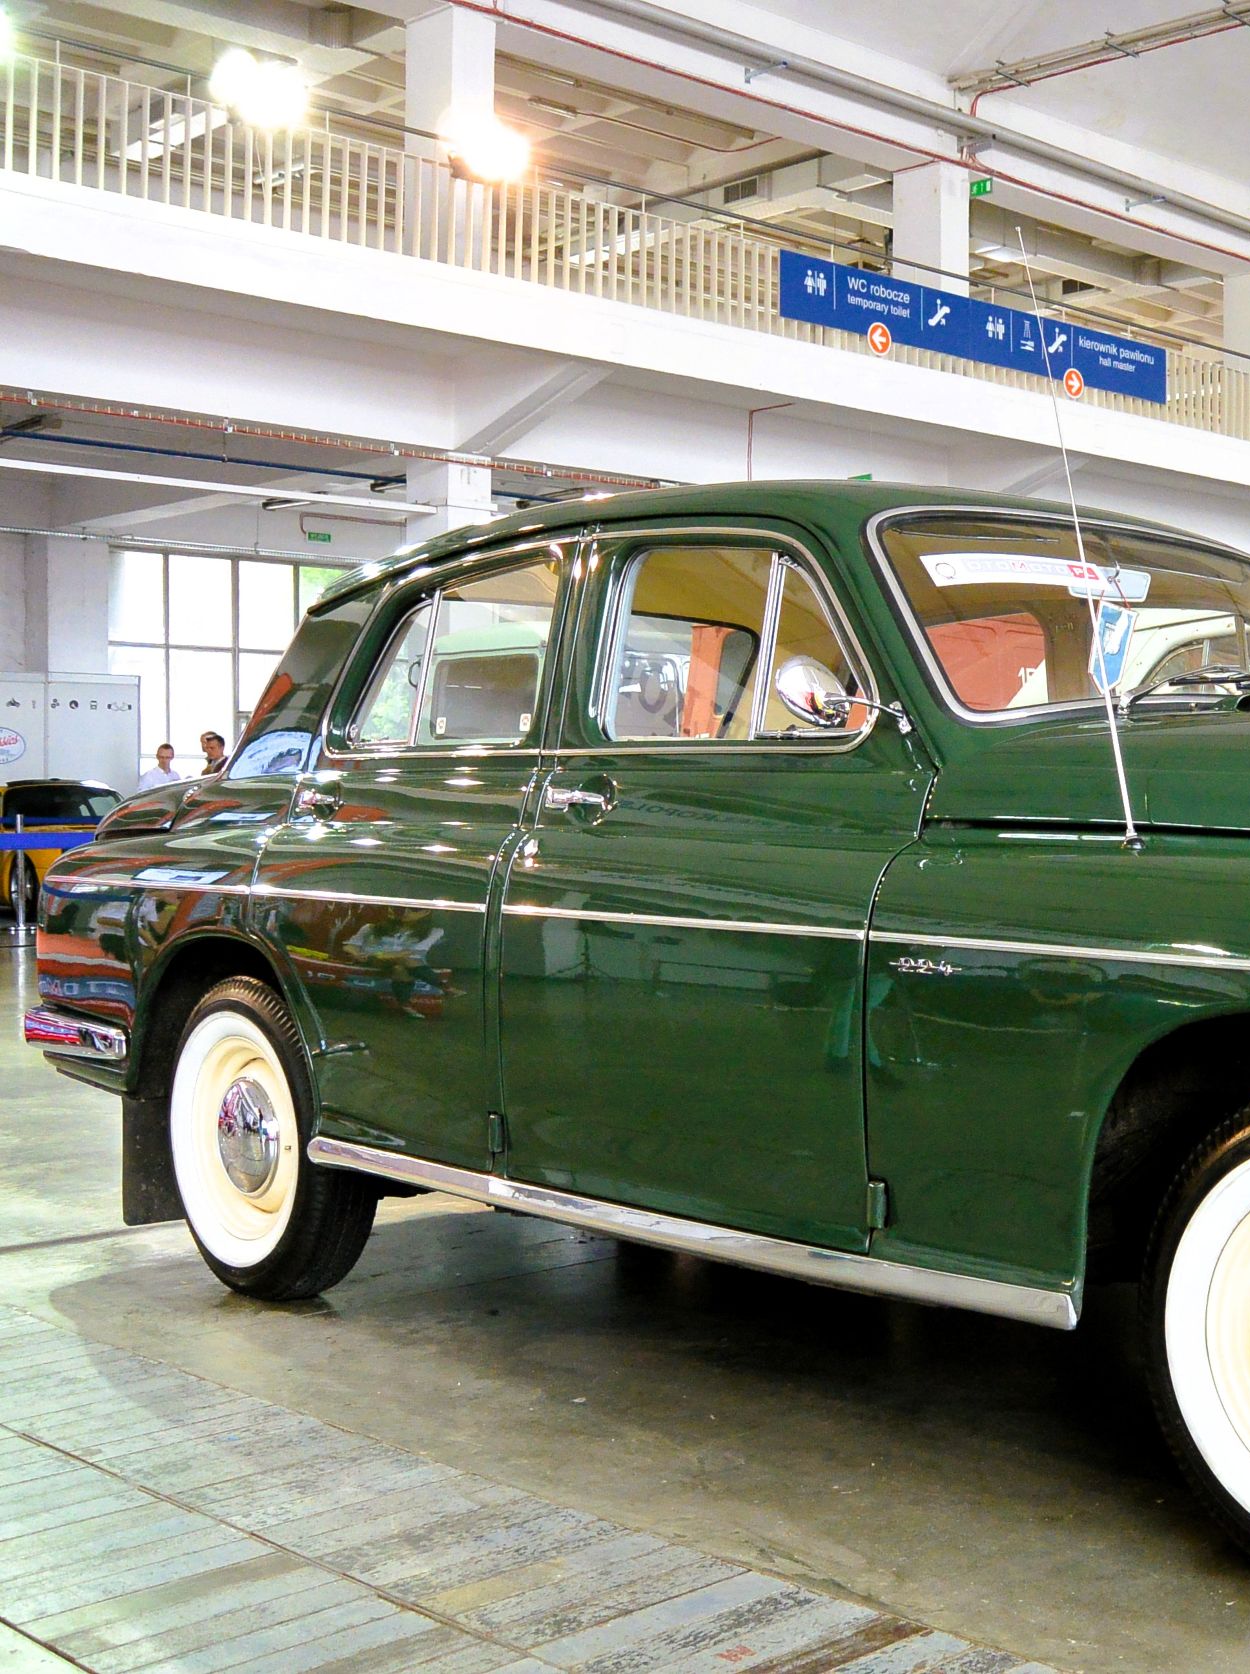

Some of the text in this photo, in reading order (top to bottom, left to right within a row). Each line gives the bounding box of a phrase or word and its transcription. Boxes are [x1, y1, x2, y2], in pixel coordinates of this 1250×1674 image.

[847, 276, 910, 304] WC robocze
[847, 294, 910, 319] temporary toilet
[1078, 335, 1154, 367] kierownik pawilonu
[1099, 356, 1136, 373] hall master
[893, 957, 957, 976] 224
